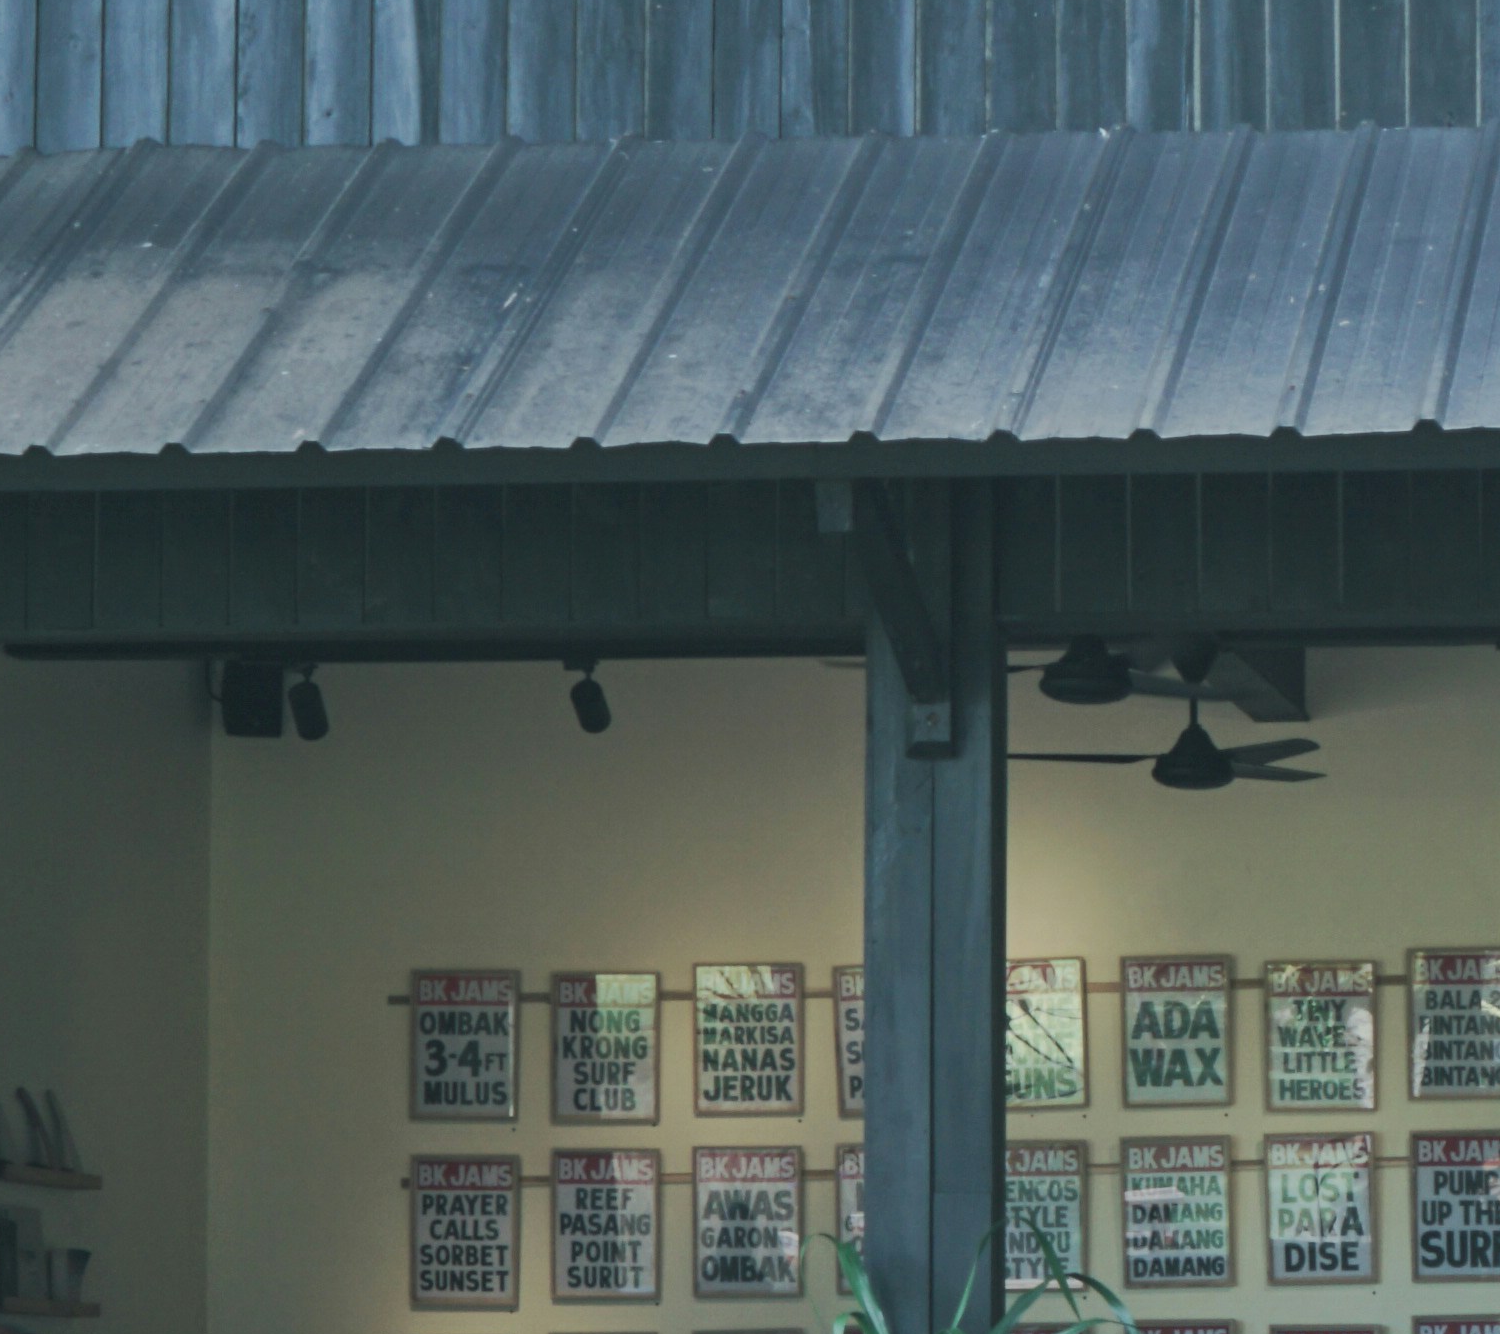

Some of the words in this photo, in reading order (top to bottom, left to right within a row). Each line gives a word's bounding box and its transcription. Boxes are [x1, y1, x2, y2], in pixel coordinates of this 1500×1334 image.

[1129, 967, 1158, 988] BK
[1160, 967, 1224, 988] JAMS
[1272, 971, 1301, 992] BK
[1305, 970, 1367, 993] JAMS
[1416, 960, 1444, 981] BK
[420, 980, 449, 1002] BK
[452, 980, 511, 1002] JAMS
[560, 982, 588, 1003] BK
[592, 982, 651, 1004] JAMS
[1426, 991, 1482, 1010] BALA
[570, 1010, 640, 1033] NONG
[702, 1003, 794, 1023] MANGGA
[1132, 1001, 1220, 1039] ADA
[1293, 1000, 1346, 1021] TINY
[420, 1011, 509, 1035] OMBAK
[703, 1026, 794, 1044] MARKISA
[562, 1036, 647, 1059] KRONG
[703, 1048, 796, 1071] NANAS
[1130, 1048, 1223, 1086] WAX
[1284, 1051, 1357, 1074] LITTLE
[574, 1062, 635, 1085] SURF
[424, 1081, 507, 1105] MULUS
[703, 1075, 792, 1101] JERUK
[1280, 1079, 1366, 1100] HEROES
[574, 1088, 635, 1111] CLUB
[1017, 1150, 1078, 1172] JAMS
[1129, 1147, 1157, 1169] BK
[1161, 1146, 1224, 1167] JAMS
[1272, 1144, 1300, 1165] BK
[1303, 1139, 1368, 1165] JAMS
[1418, 1141, 1448, 1162] BK
[419, 1165, 447, 1186] BK
[451, 1165, 512, 1187] JAMS
[559, 1159, 587, 1180] BK
[591, 1159, 653, 1180] JAMS
[700, 1156, 729, 1178] BK
[732, 1156, 795, 1178] JAMS
[1132, 1176, 1221, 1196] KUMAHA
[1281, 1173, 1359, 1203] LOST
[1434, 1171, 1498, 1195] PUMP
[422, 1194, 509, 1215] PRAYER
[576, 1188, 633, 1210] REEF
[704, 1190, 795, 1220] AWAS
[1132, 1204, 1223, 1223] DAMANG
[1278, 1206, 1364, 1237] PARA
[1421, 1201, 1452, 1225] UP
[430, 1220, 499, 1240] CALLS
[560, 1214, 651, 1236] PASANG
[1127, 1230, 1223, 1250] DAMANG
[420, 1245, 508, 1266] SORBET
[571, 1241, 641, 1262] POINT
[1284, 1242, 1359, 1272] DISE
[568, 1267, 643, 1288] SURUT
[701, 1256, 796, 1283] OMBAK
[1133, 1257, 1225, 1277] DAMANG
[420, 1270, 508, 1291] SUNSET
